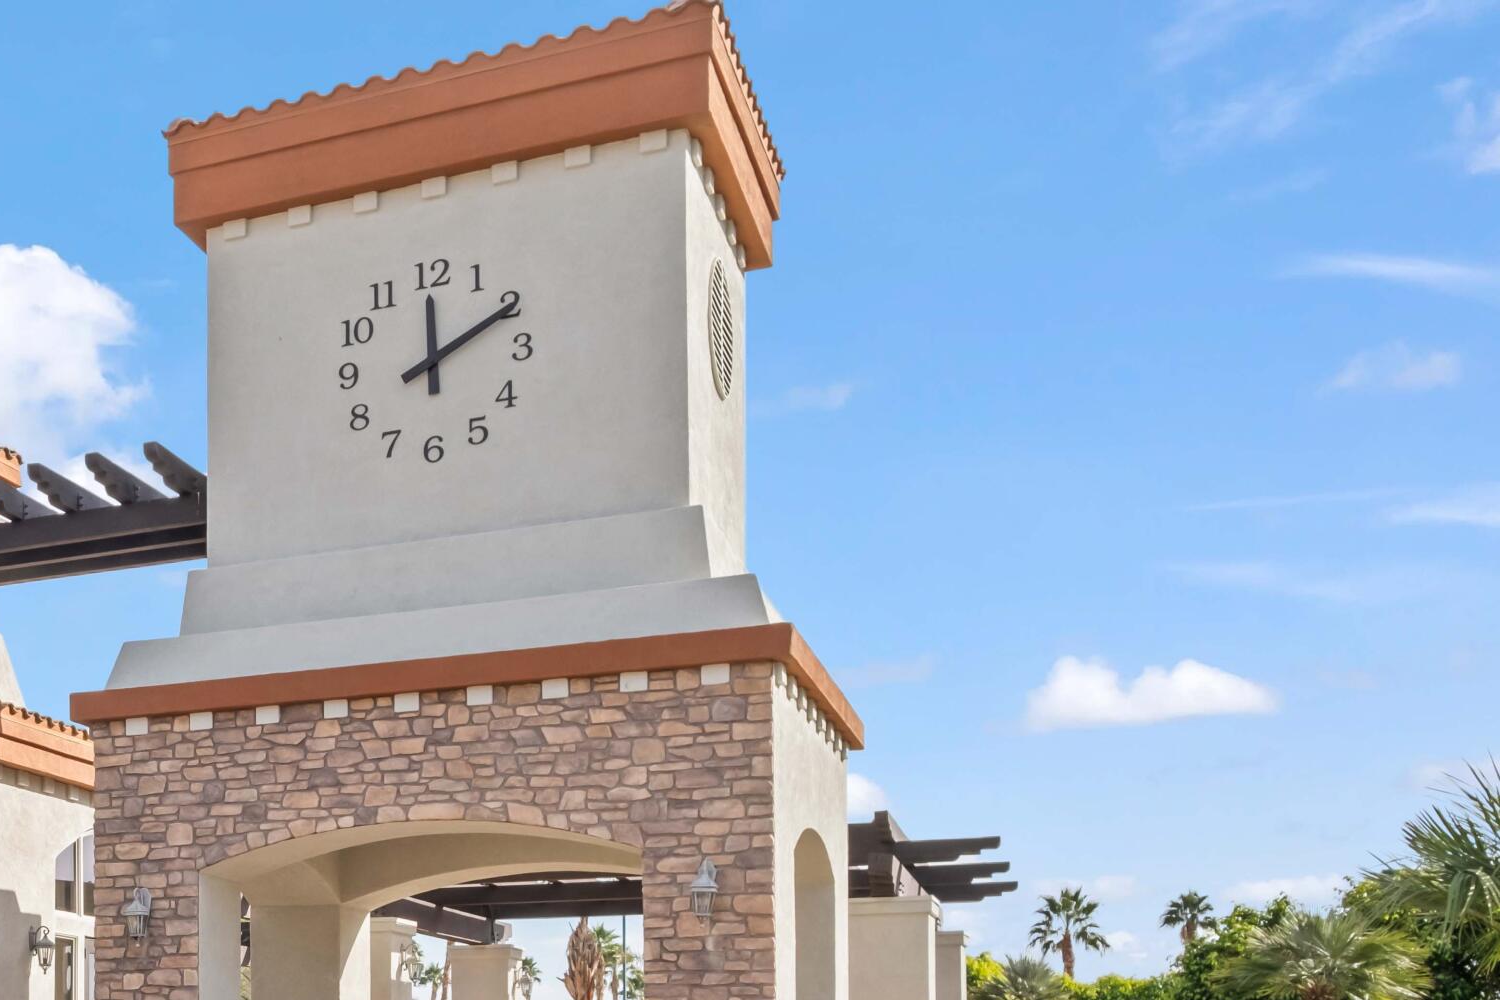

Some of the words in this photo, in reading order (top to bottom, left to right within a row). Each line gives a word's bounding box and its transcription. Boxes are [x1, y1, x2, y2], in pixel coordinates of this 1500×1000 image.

[414, 258, 451, 291] 12
[470, 263, 485, 293] 1
[369, 280, 397, 311] 11
[500, 290, 521, 320] 2
[341, 316, 374, 347] 10
[512, 332, 534, 361] 3
[338, 362, 359, 390] 9
[495, 379, 518, 408] 4
[349, 403, 370, 431] 8
[467, 415, 489, 446] 5
[381, 429, 402, 459] 7
[423, 435, 445, 464] 6
